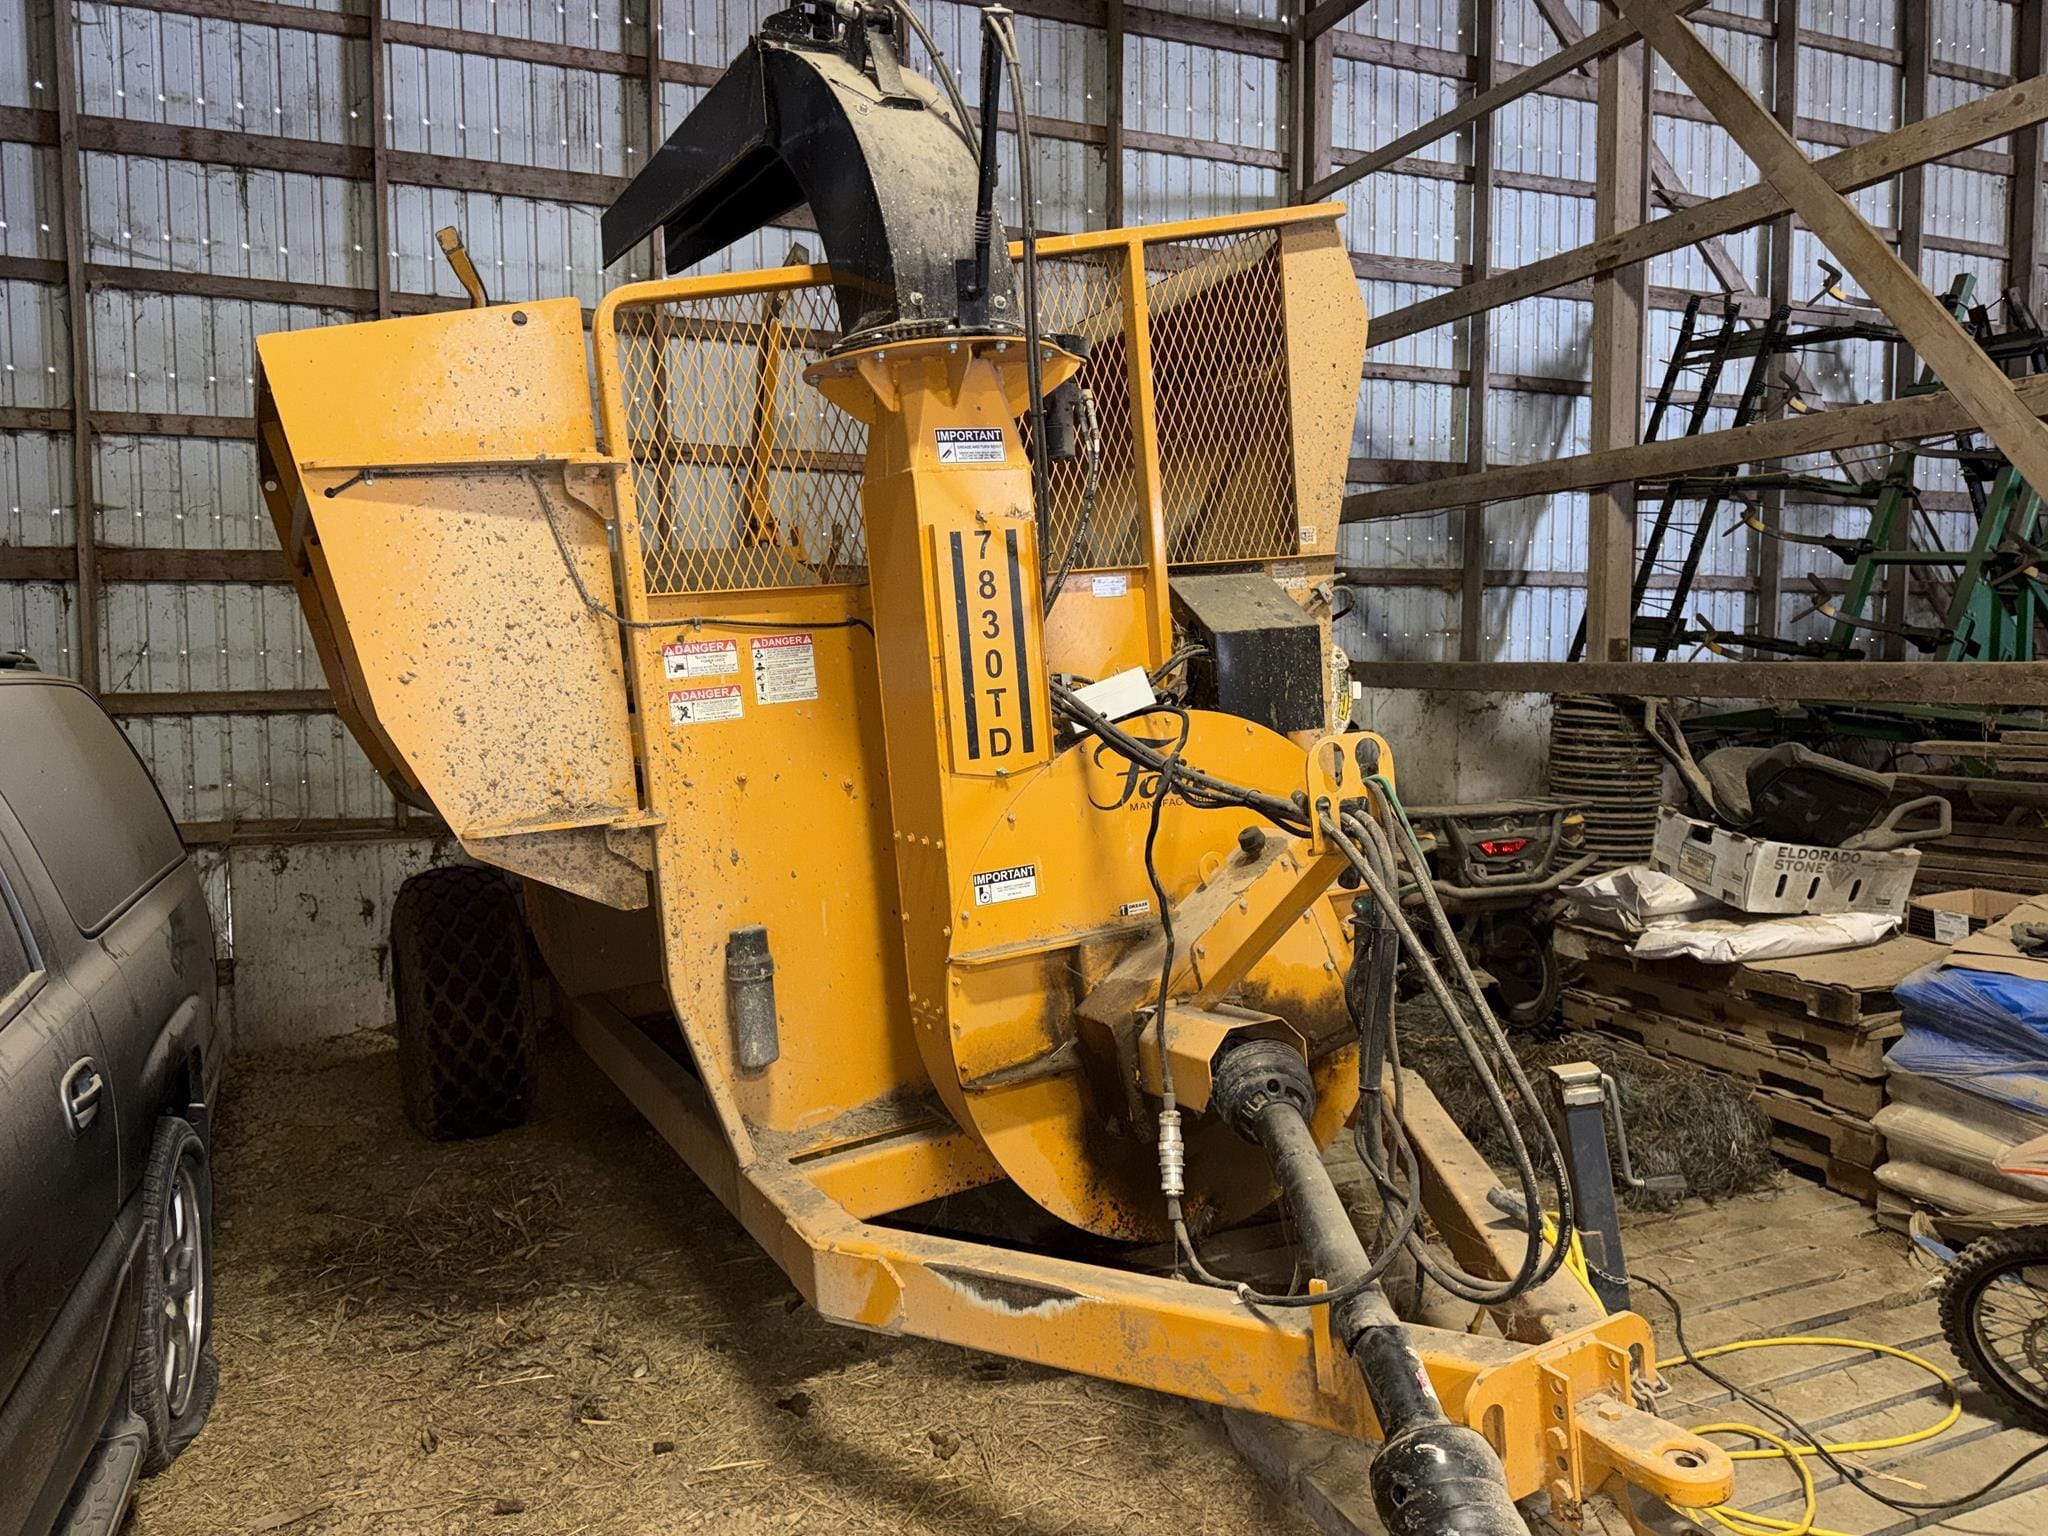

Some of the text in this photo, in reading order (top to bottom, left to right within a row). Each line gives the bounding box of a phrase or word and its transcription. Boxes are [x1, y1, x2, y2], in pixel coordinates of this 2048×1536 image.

[937, 430, 1001, 441] IMPORTANT
[674, 642, 724, 655] DANGER
[761, 636, 803, 647] DANGER
[974, 529, 1012, 757] 7830TD
[680, 687, 730, 701] DANGER
[1777, 846, 1862, 863] ELDORADO
[1774, 859, 1827, 874] STONE
[974, 866, 1034, 886] IMPORTANT
